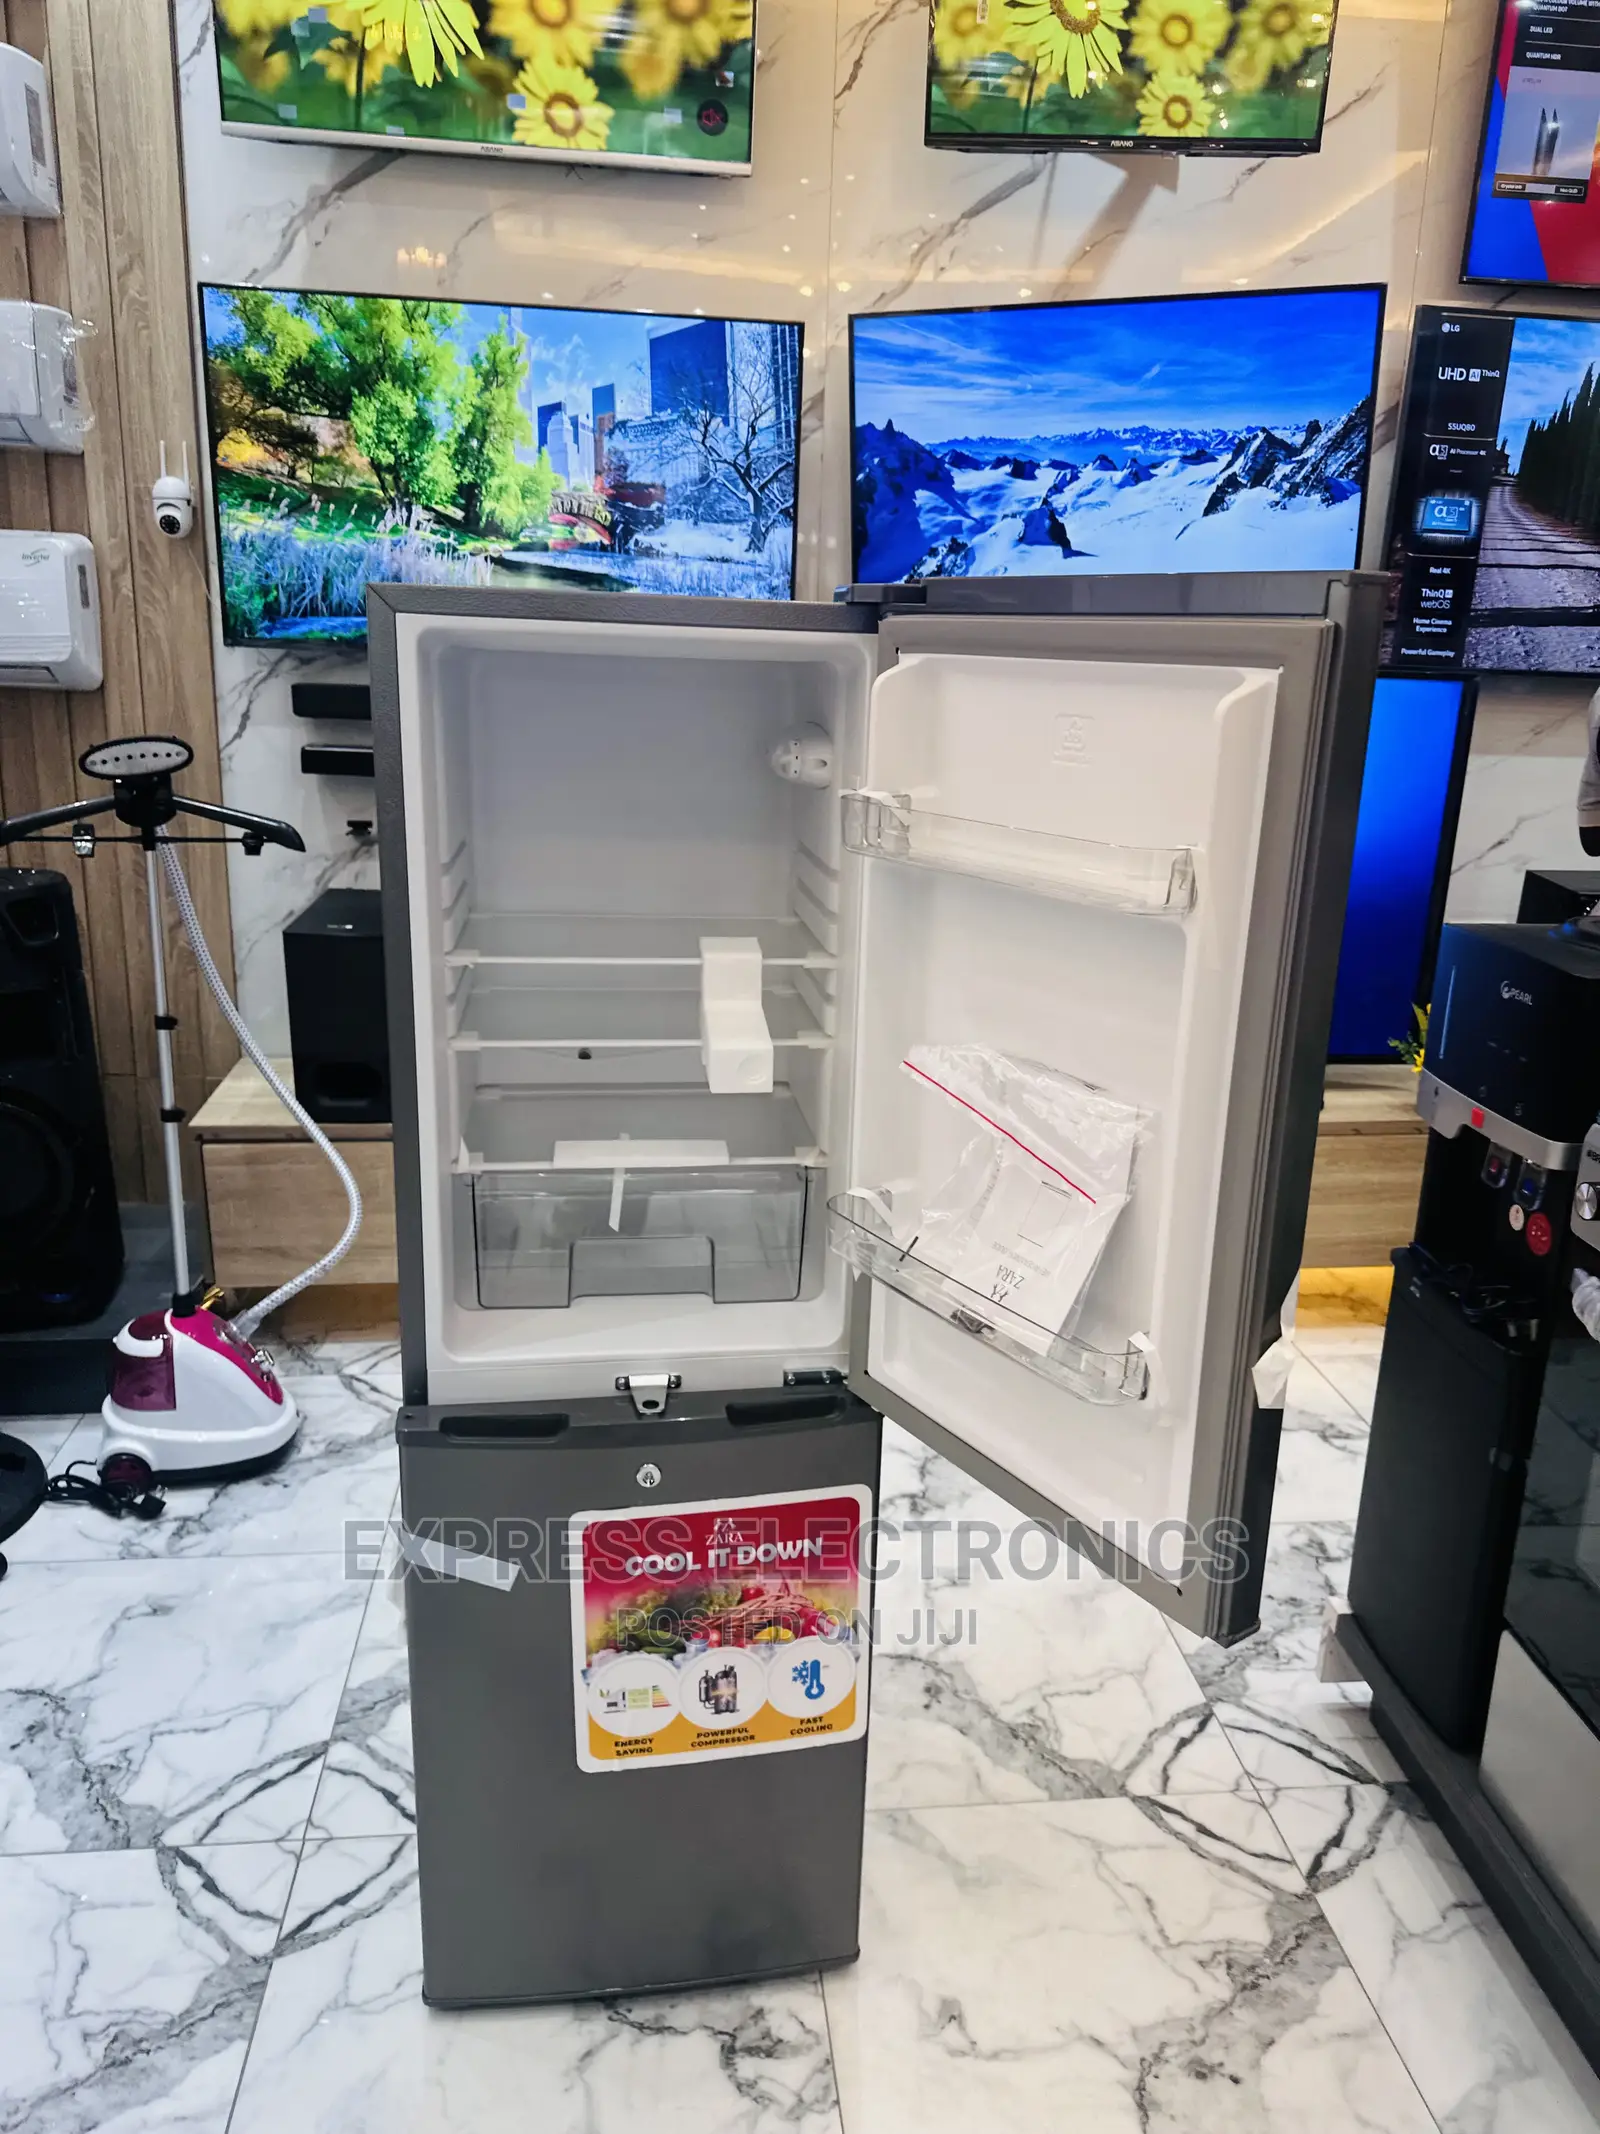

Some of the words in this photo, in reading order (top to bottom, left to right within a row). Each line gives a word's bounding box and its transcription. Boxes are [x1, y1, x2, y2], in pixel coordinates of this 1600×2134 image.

[1526, 52, 1550, 60] QUANTUM
[1438, 366, 1467, 381] UHD
[1469, 368, 1481, 382] AI
[1482, 369, 1500, 378] ThinQ
[1421, 588, 1445, 598] ThinQ
[1421, 599, 1451, 609] webOS
[1416, 625, 1448, 633] Experience
[1401, 647, 1427, 656] Powerful
[1427, 649, 1456, 658] Gameplay
[1510, 987, 1533, 1006] PEARL
[995, 1264, 1025, 1290] ZARA
[705, 1531, 744, 1546] ZARA
[625, 1551, 702, 1577] COOL
[708, 1547, 734, 1569] IT
[737, 1537, 823, 1566] DOWN
[800, 1716, 824, 1726] FAST
[696, 1727, 750, 1739] POWERFUL
[790, 1724, 834, 1736] COOLING
[614, 1737, 654, 1748] ENERGY
[690, 1735, 756, 1748] COMPRESSOR
[615, 1746, 654, 1757] SAVING
